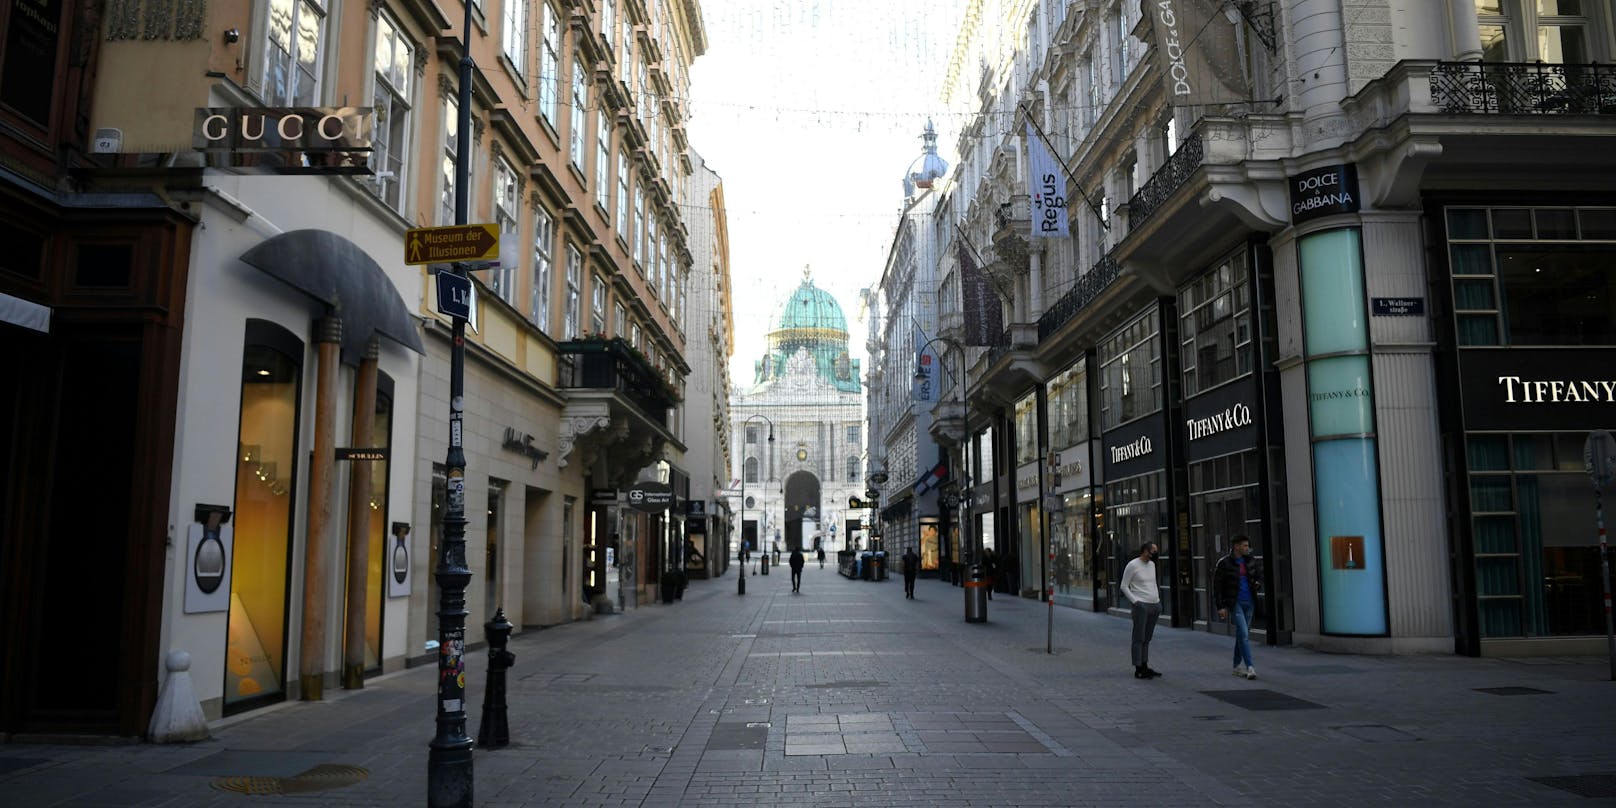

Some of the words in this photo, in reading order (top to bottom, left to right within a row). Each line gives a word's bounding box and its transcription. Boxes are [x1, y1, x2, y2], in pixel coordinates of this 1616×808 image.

[1165, 36, 1191, 96] DOLCE
[202, 114, 362, 140] GUCCI
[1298, 173, 1338, 193] DOLCE
[1042, 174, 1064, 232] Regus
[1293, 192, 1353, 215] GABBANA
[424, 233, 463, 245] Museum
[466, 230, 482, 241] der
[429, 246, 476, 258] Illusionen
[1498, 376, 1616, 403] TIFFANY
